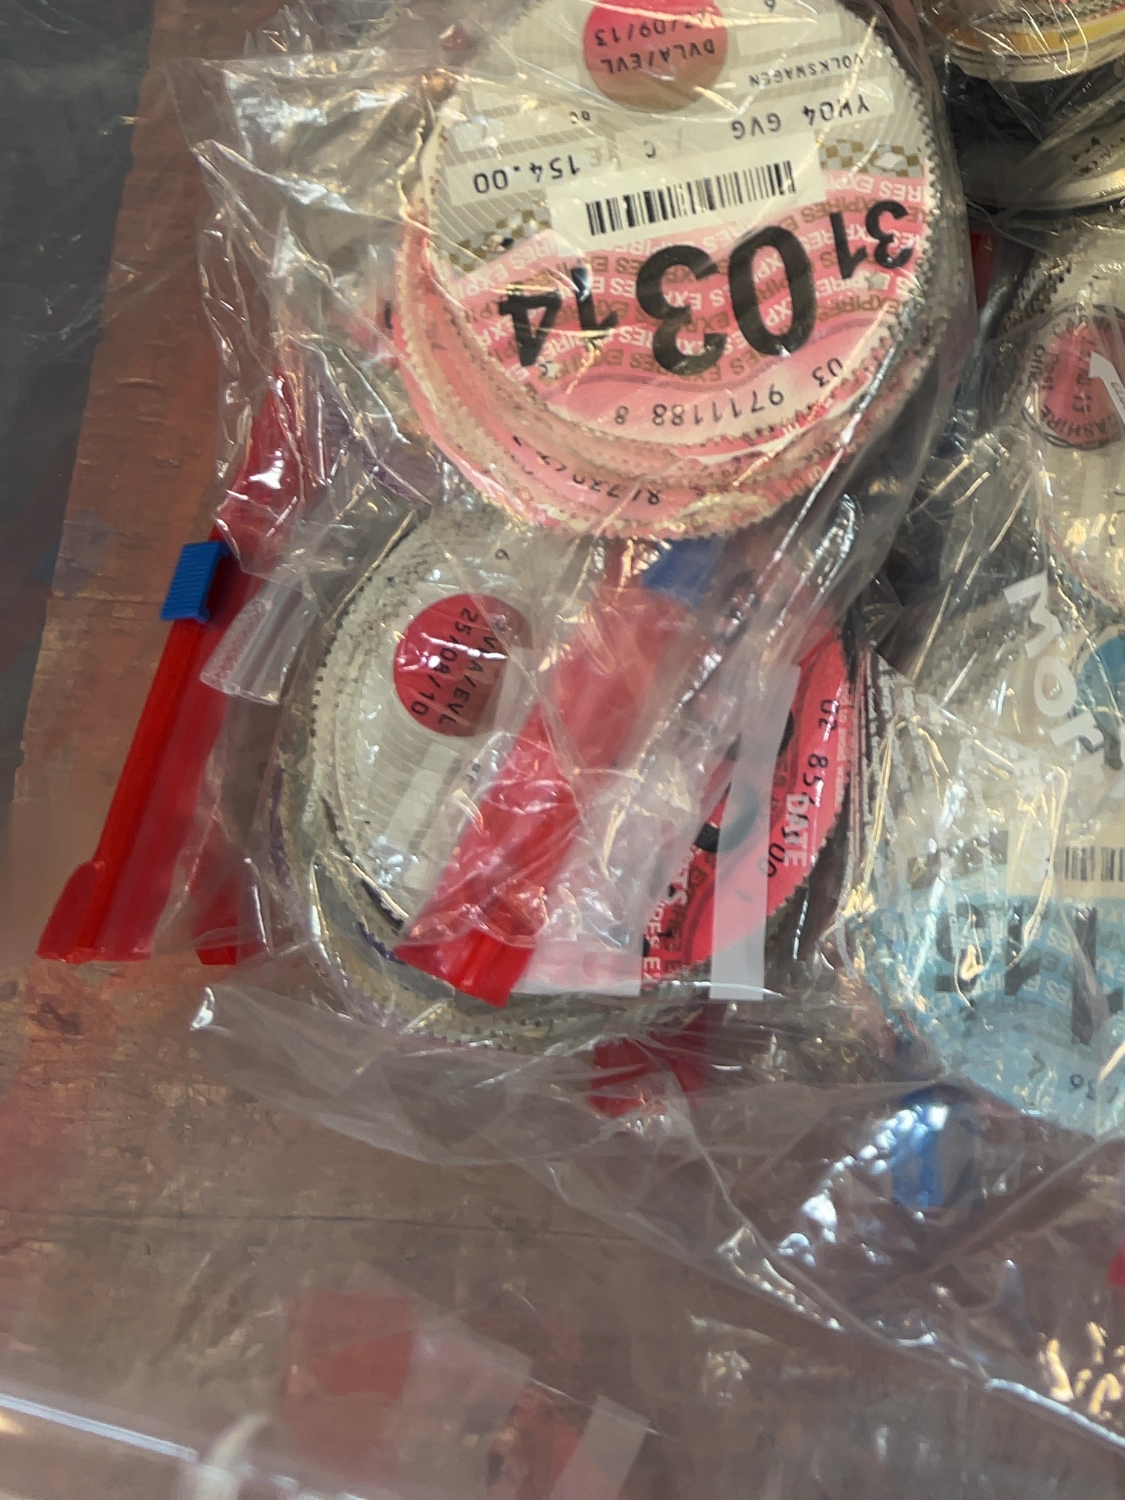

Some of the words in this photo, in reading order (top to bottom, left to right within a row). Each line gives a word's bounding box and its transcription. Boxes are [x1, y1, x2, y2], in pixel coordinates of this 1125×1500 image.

[591, 6, 717, 47] /09/13
[598, 37, 716, 76] DVLA/EVL
[745, 50, 866, 91] VOLKSWAGEN
[727, 110, 783, 141] GVG
[826, 195, 918, 279] 31
[490, 260, 620, 371] 14
[626, 220, 826, 381] 03
[646, 379, 785, 432] 9711188
[780, 792, 812, 868] DATE
